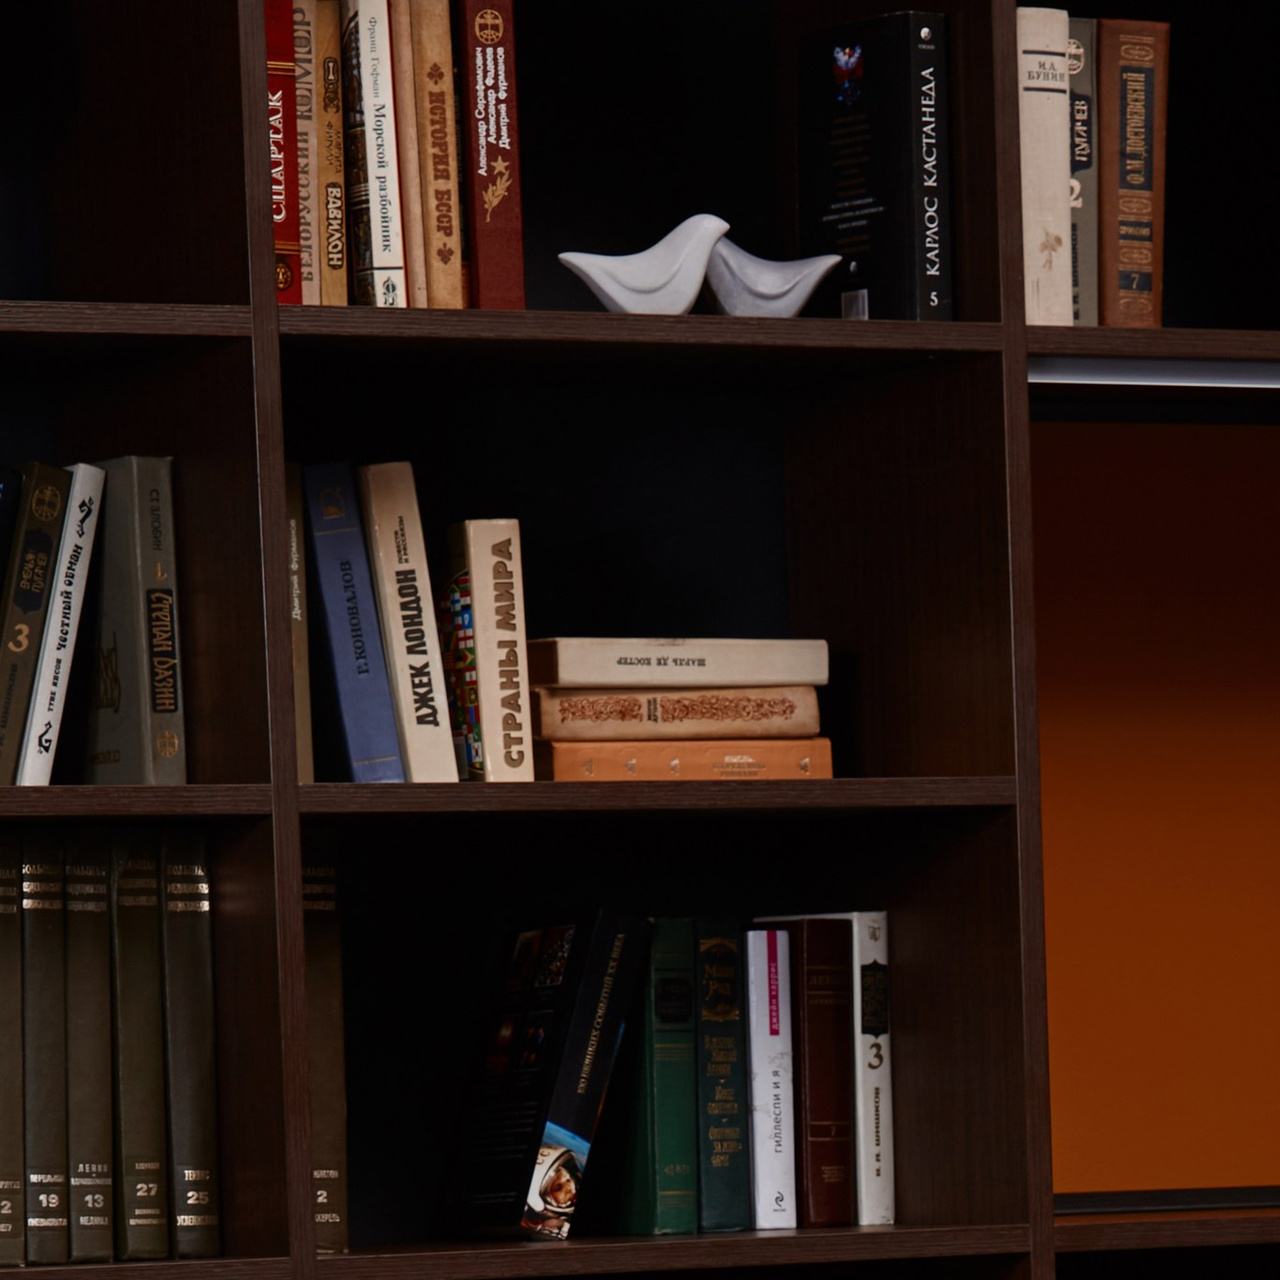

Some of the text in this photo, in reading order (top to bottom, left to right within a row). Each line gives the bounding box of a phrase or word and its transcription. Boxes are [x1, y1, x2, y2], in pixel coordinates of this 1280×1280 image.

[368, 17, 378, 56] Франц
[475, 47, 487, 176] Александр Серафимович
[487, 89, 496, 144] Александр
[497, 47, 510, 149] Дмитрий Фурманов
[920, 66, 938, 187] КАСТАНЕДА
[373, 104, 387, 169] Морской
[428, 91, 454, 237] ИСТОРИЯ БССР
[326, 185, 343, 268] ВАВИЛОН
[378, 175, 392, 252] разбойник
[923, 196, 940, 276] КАРЛОС
[1131, 273, 1139, 289] 7
[289, 519, 298, 571] Фурманов
[8, 623, 30, 653] 3
[56, 588, 72, 651] ЧЕСТНЫЙ
[395, 569, 439, 727] ДЖЕК ЛОНДОН
[150, 592, 177, 712] СТЕПАН РАЗИН
[491, 538, 524, 768] СТРАНЫ МИРА
[868, 1043, 883, 1070] 3
[772, 1094, 783, 1154] гиллеспи
[38, 1193, 59, 1208] 19
[84, 1194, 104, 1208] 13
[135, 1183, 158, 1197] 27
[186, 1190, 209, 1205] 25
[316, 1190, 327, 1203] 2
